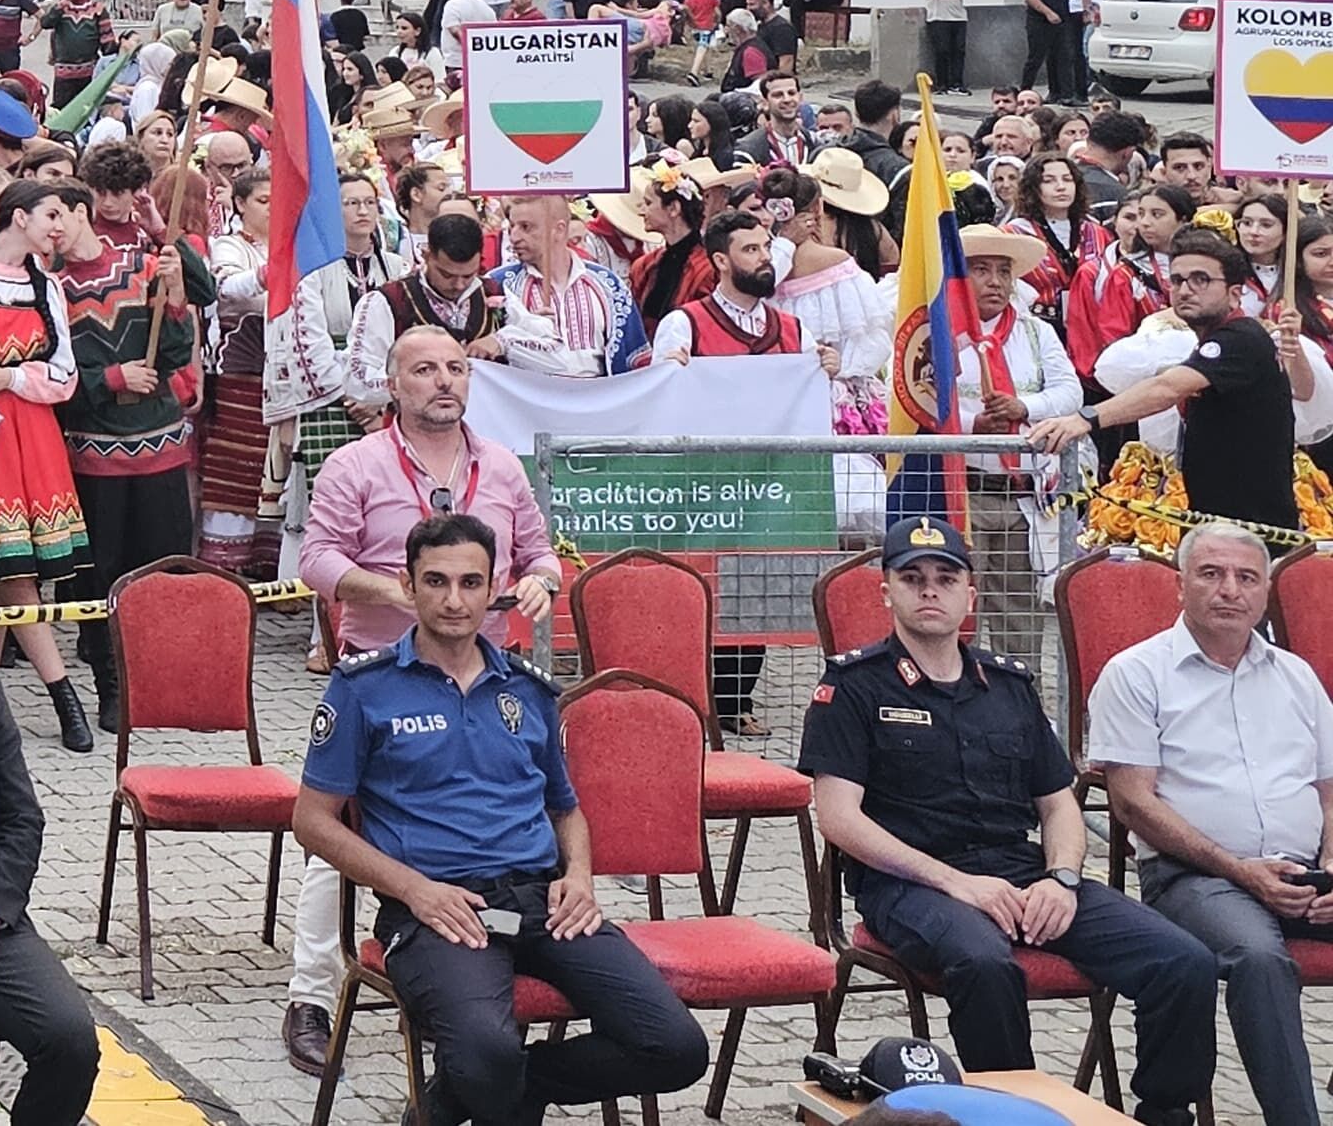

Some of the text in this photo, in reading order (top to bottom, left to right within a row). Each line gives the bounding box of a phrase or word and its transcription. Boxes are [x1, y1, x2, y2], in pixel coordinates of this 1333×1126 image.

[1237, 8, 1333, 27] KOLOMB
[471, 29, 617, 52] BULGARİSTAN
[1273, 38, 1293, 46] LOS
[516, 51, 574, 64] ARATLİTSİ
[551, 479, 791, 505] tradition is alive,
[643, 513, 676, 532] to
[686, 507, 744, 535] you!
